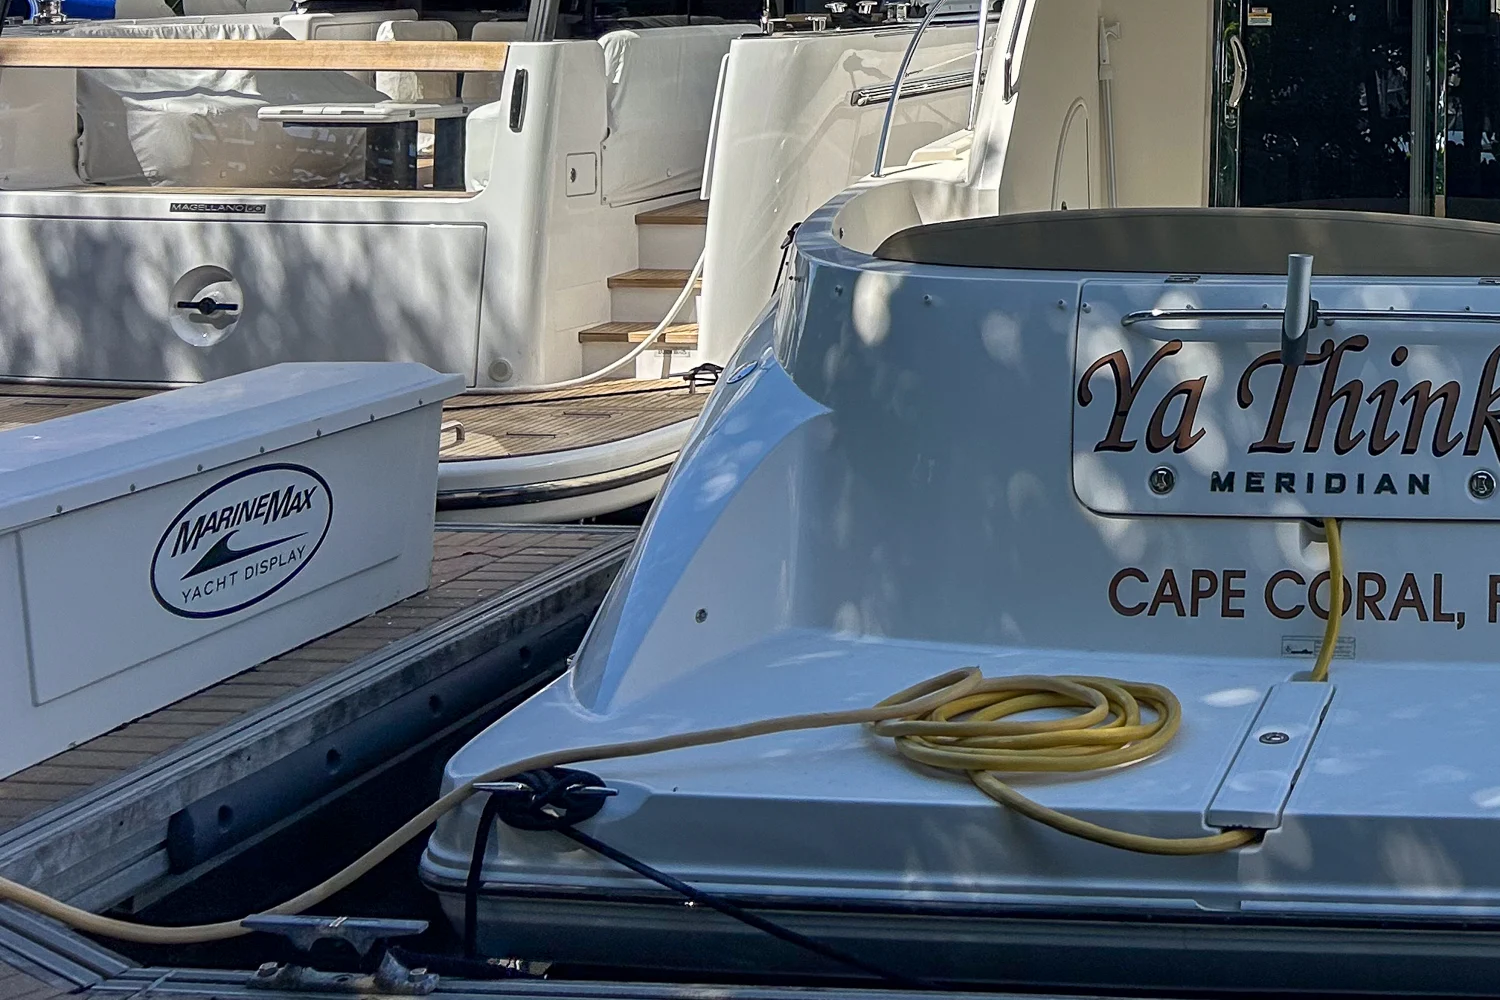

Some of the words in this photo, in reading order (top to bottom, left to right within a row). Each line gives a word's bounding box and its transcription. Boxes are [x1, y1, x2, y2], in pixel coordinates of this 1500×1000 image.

[171, 203, 244, 212] MAGELLANO
[1077, 338, 1208, 454] Ya
[1209, 470, 1431, 496] MERIDIAN
[181, 571, 239, 604] YACHT
[244, 544, 307, 581] DISPLAY
[1107, 567, 1247, 619] CAPE
[1264, 569, 1466, 631] CORAL,
